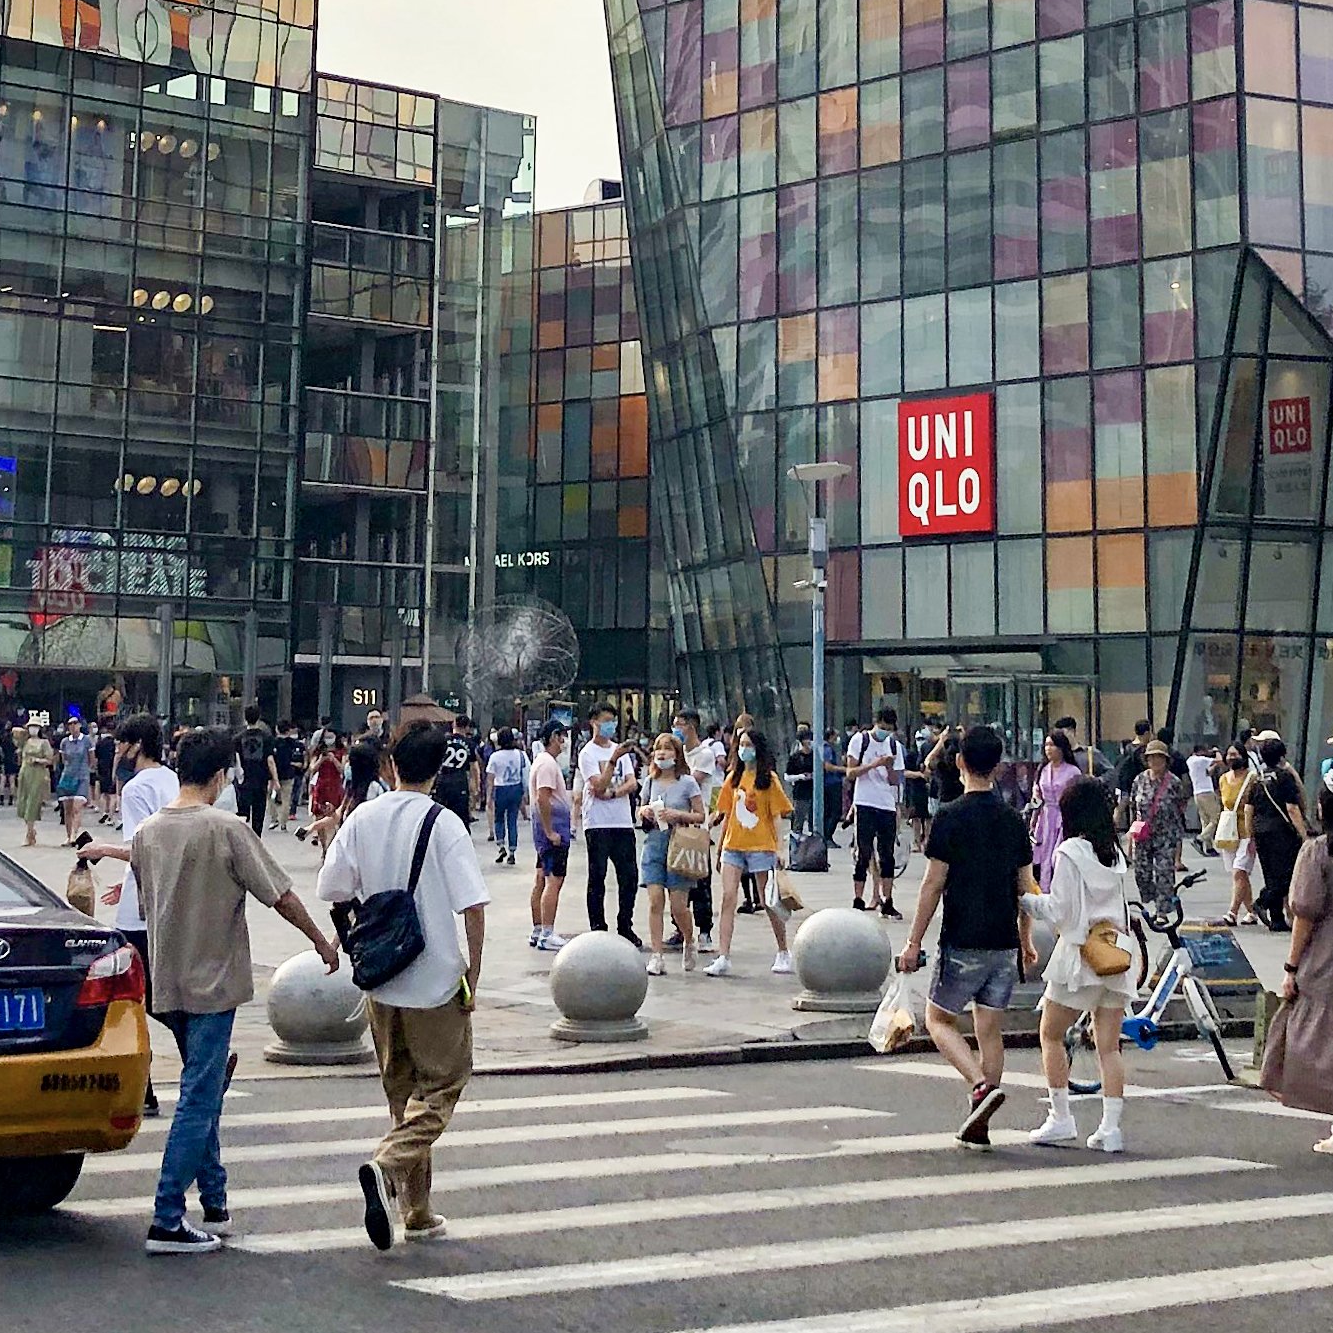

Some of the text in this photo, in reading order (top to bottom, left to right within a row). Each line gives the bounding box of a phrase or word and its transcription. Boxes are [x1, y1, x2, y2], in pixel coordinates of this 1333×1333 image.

[1274, 404, 1304, 425] UNI
[907, 410, 974, 461] UNI
[1274, 427, 1307, 450] QLO
[907, 468, 981, 525] QLO
[353, 689, 376, 706] S11
[443, 747, 468, 769] 29
